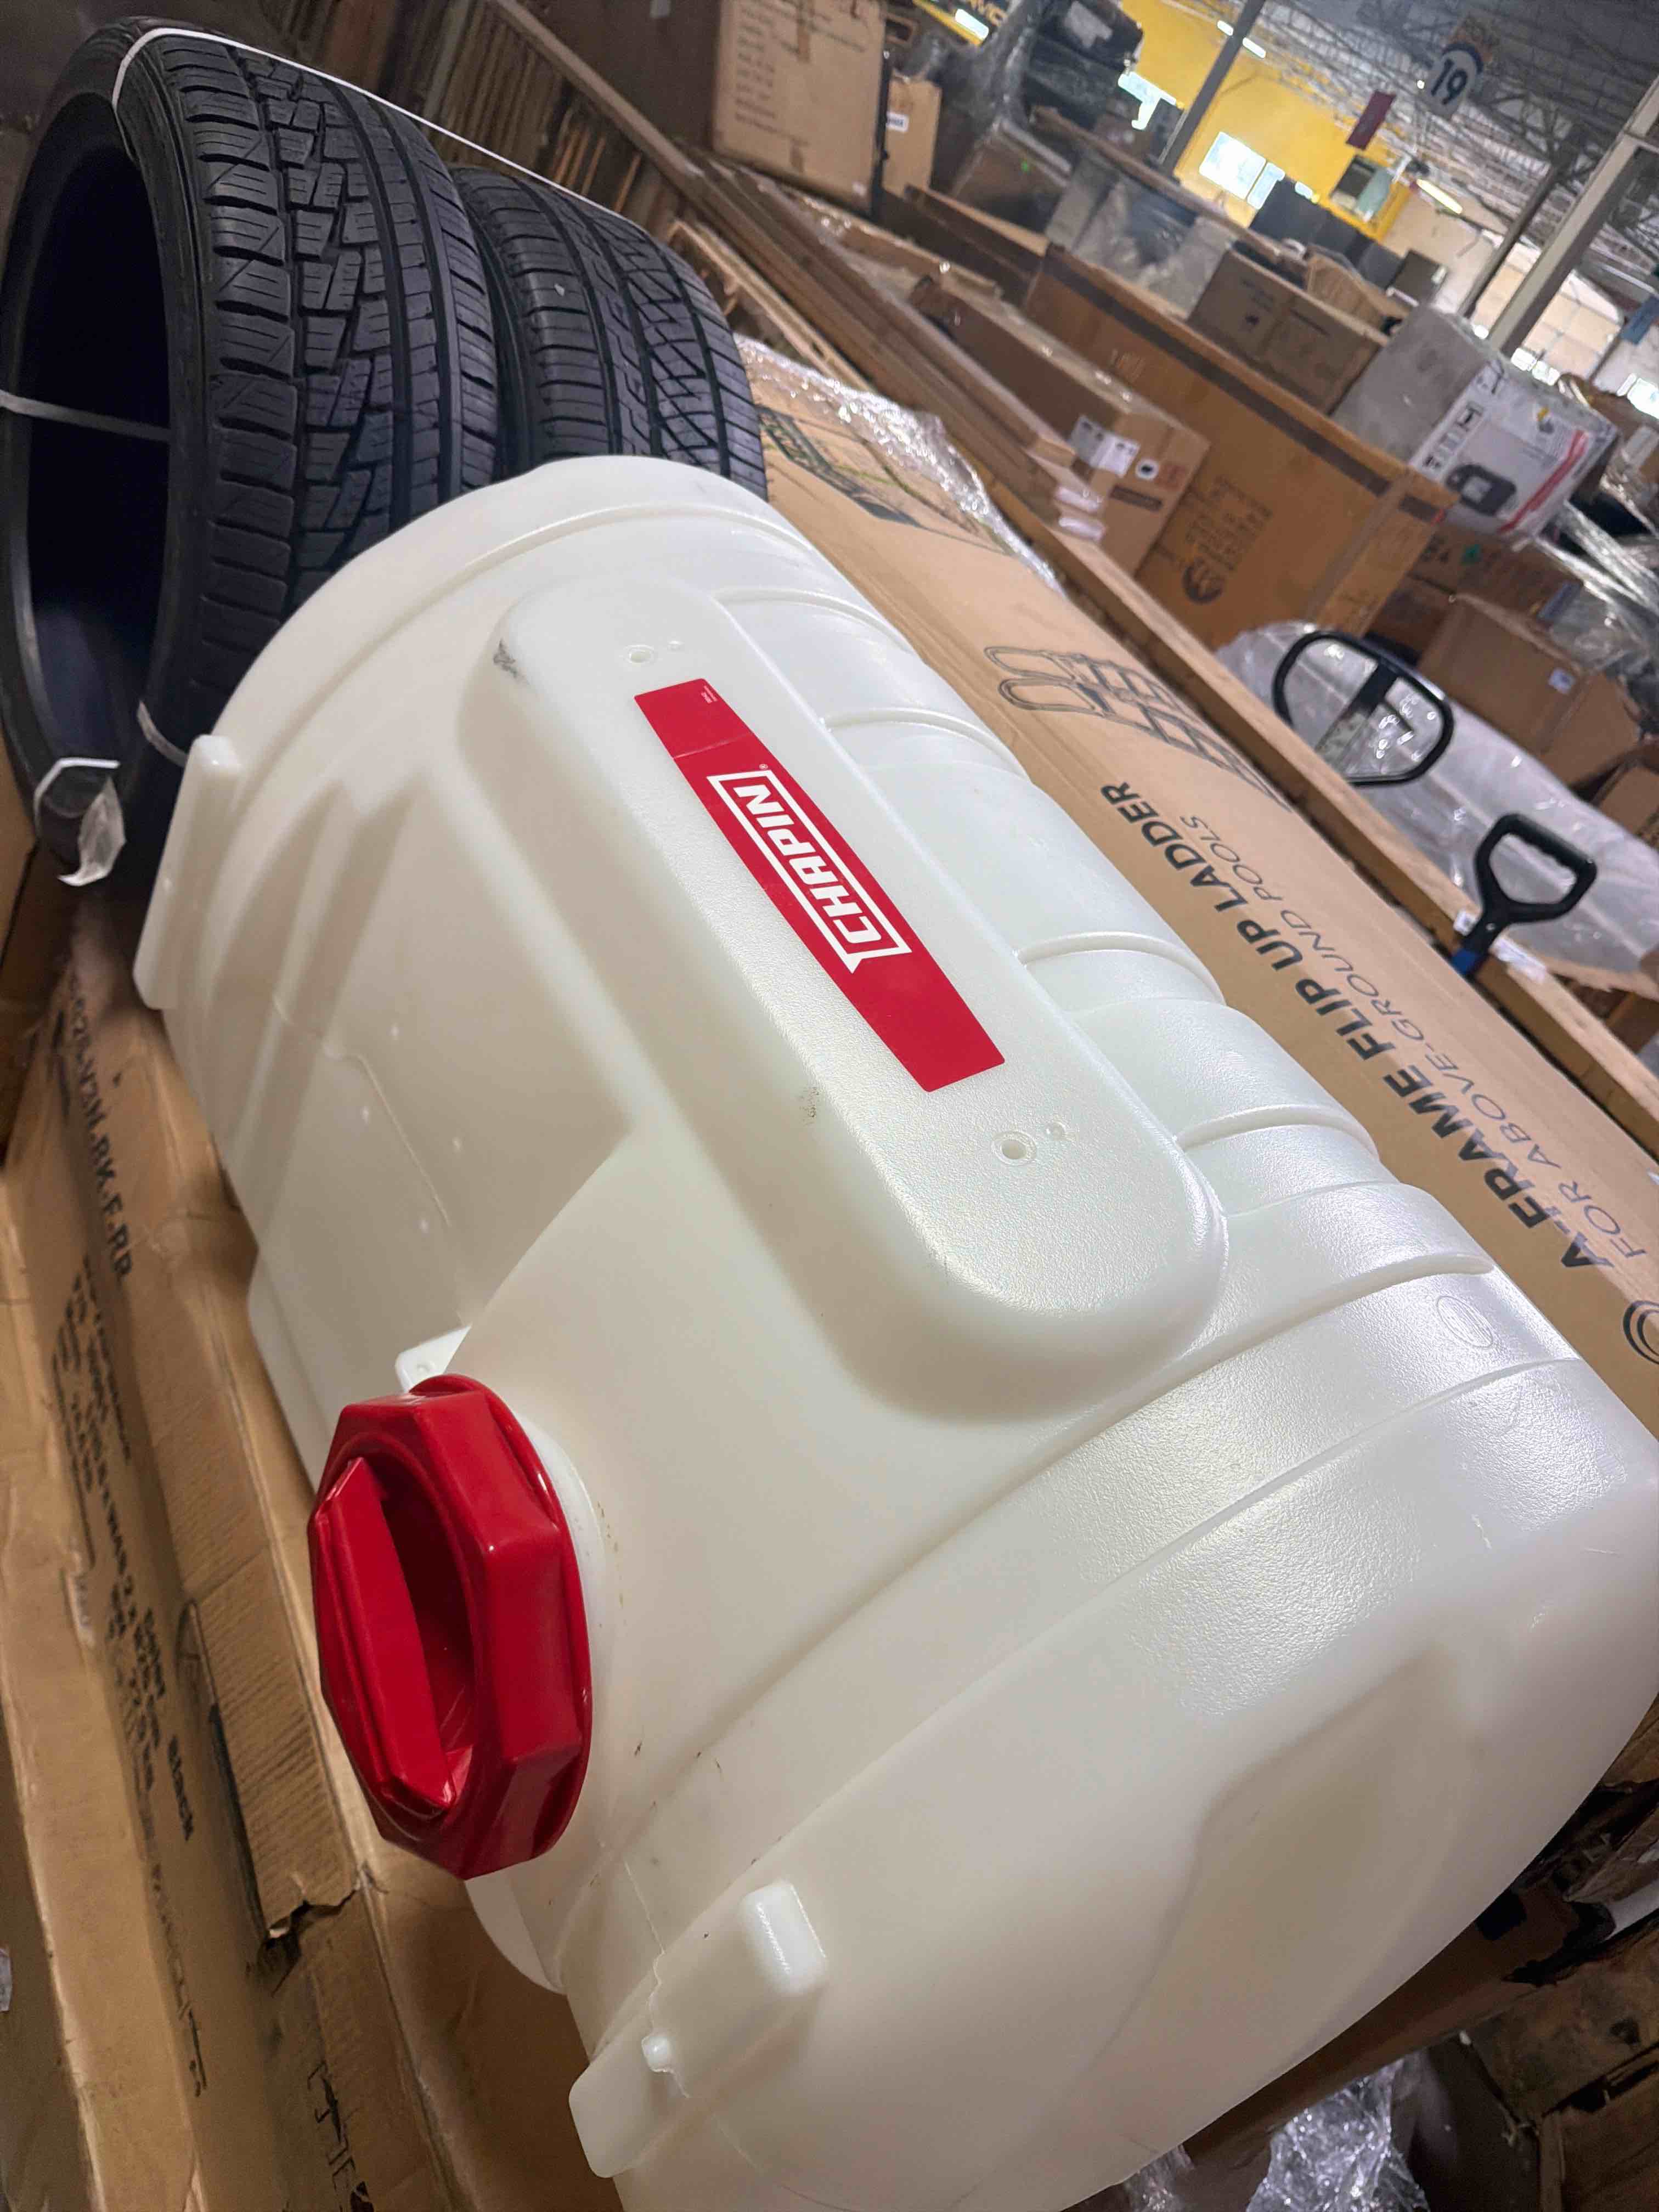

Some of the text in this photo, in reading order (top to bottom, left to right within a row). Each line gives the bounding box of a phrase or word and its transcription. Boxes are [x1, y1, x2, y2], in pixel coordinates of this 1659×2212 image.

[1431, 58, 1468, 105] 19
[733, 784, 882, 944] CHAPIN
[1180, 816, 1283, 900] POOLS
[1101, 782, 1614, 1267] A-FRAME FLIP UP LADDER
[1280, 910, 1561, 1169] ABOVE-GROUND
[1558, 1181, 1647, 1258] FOR
